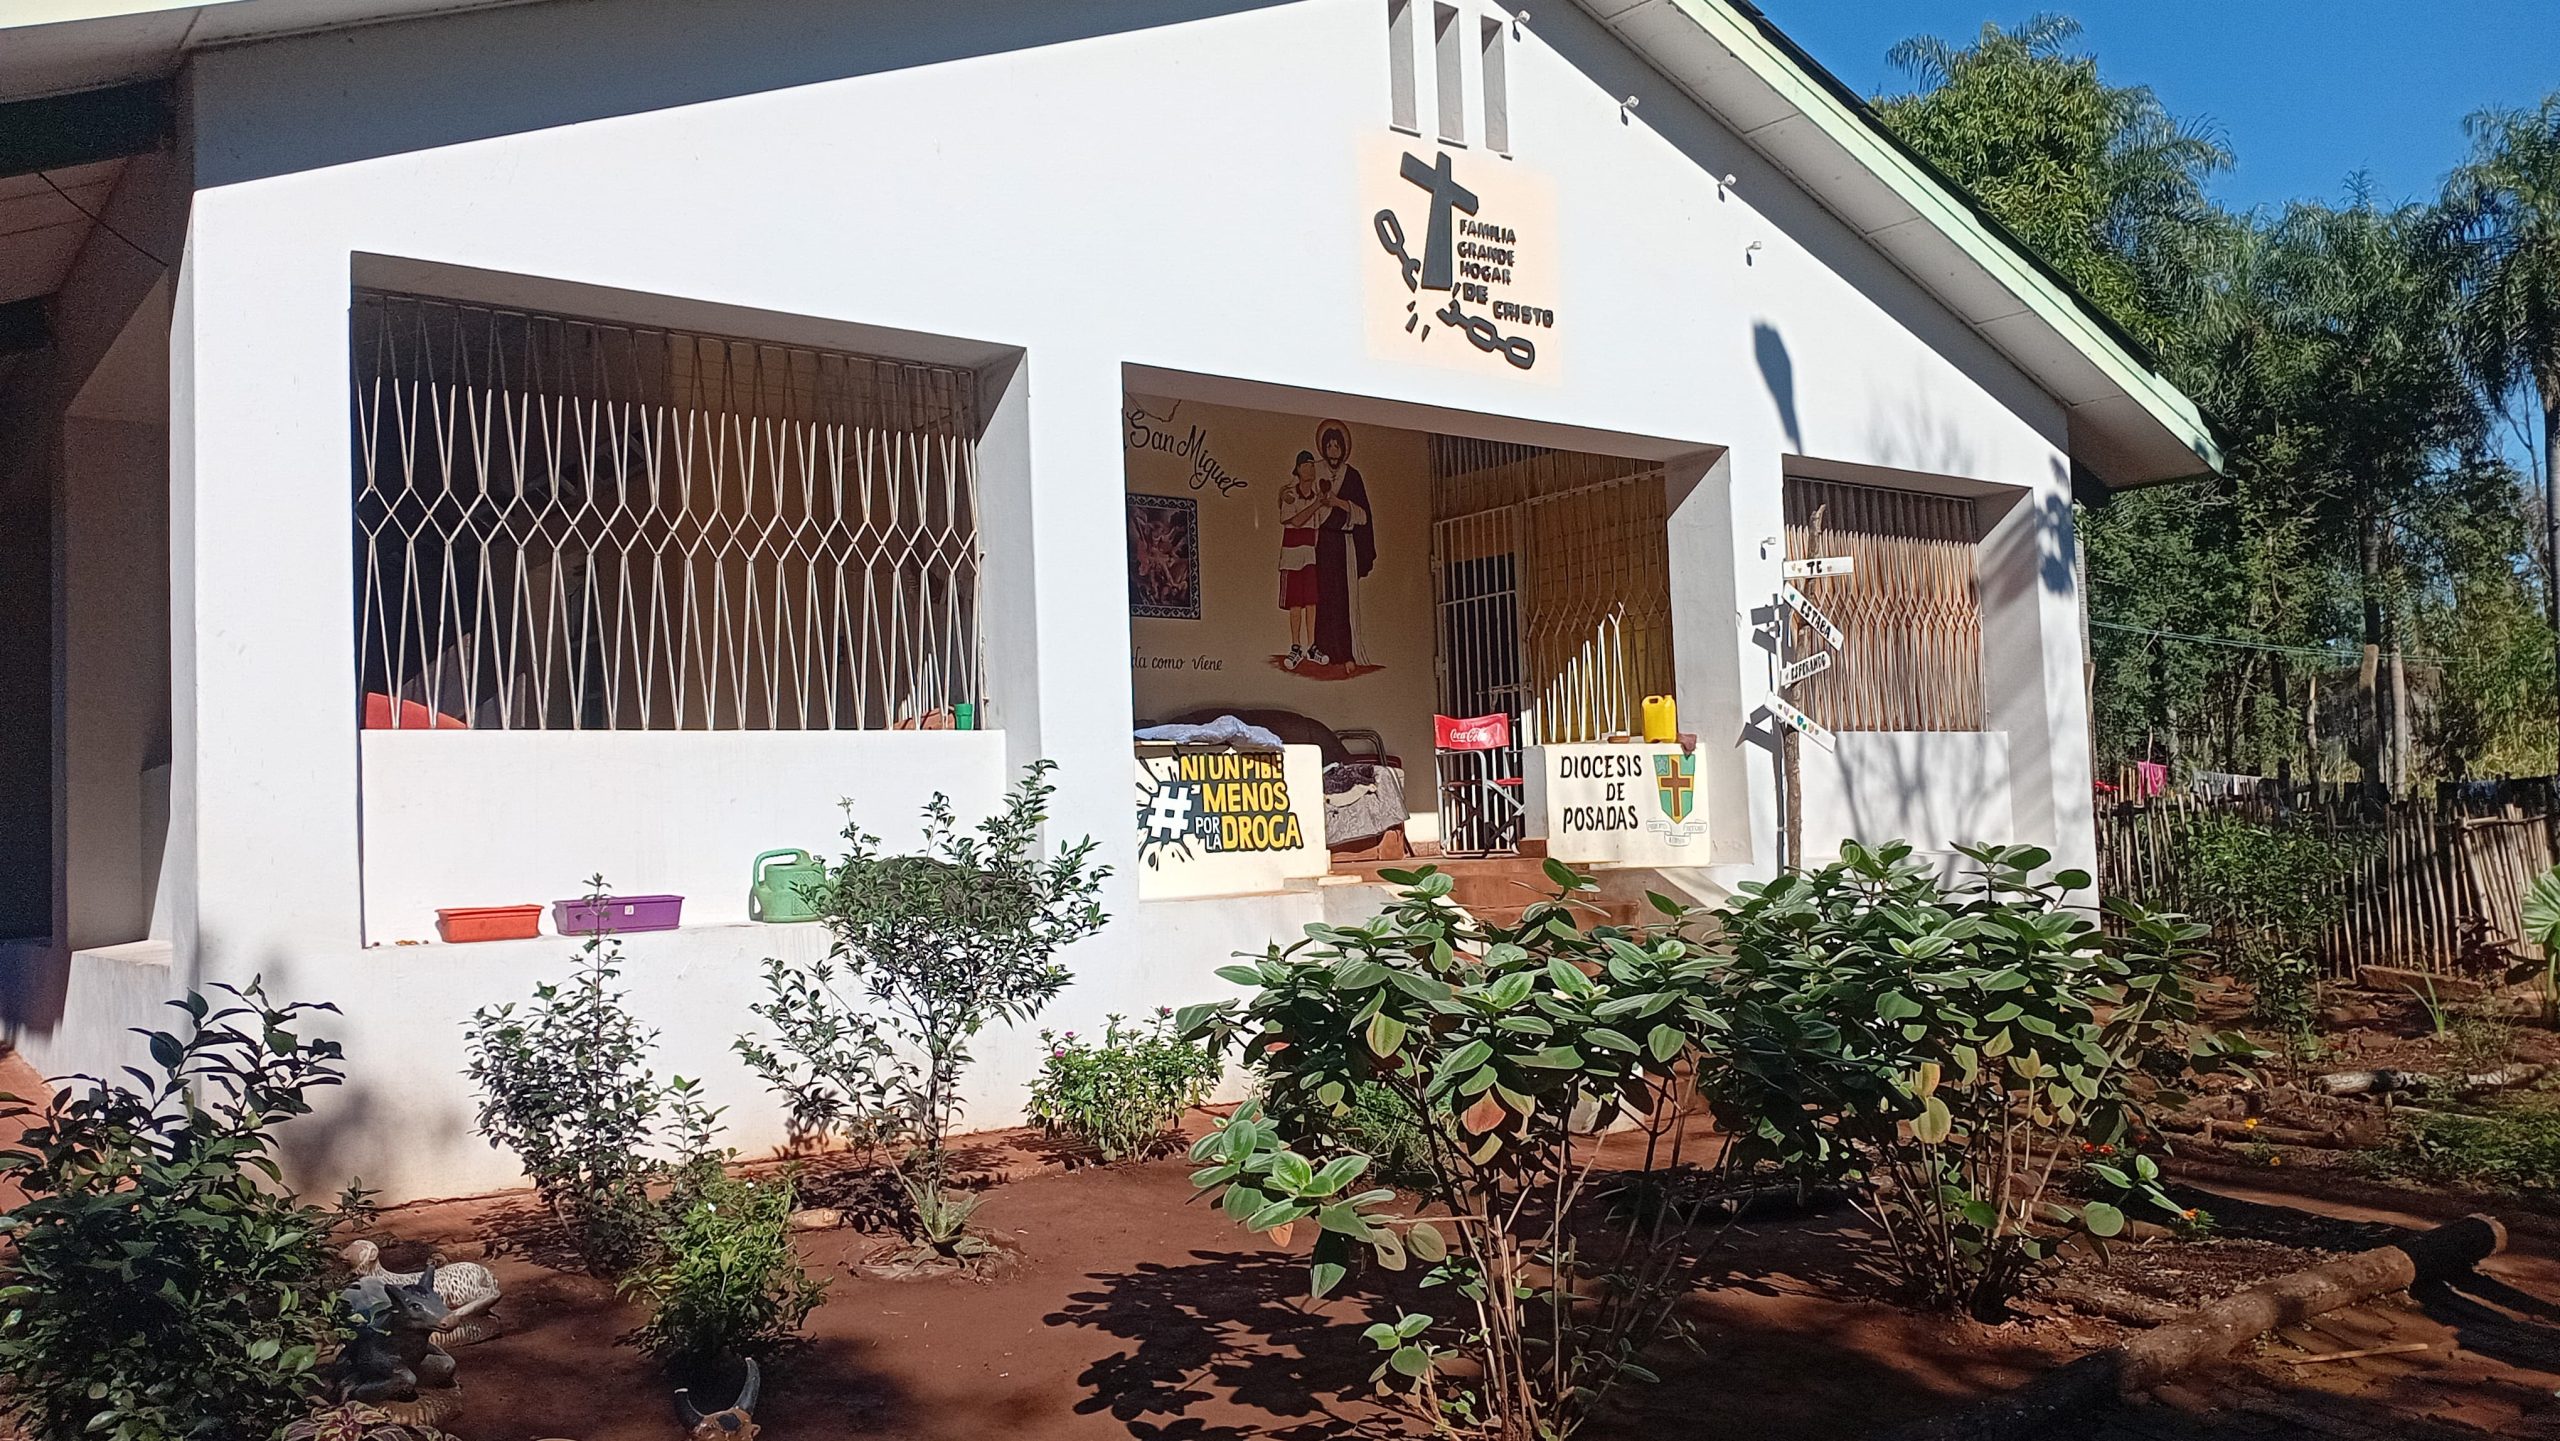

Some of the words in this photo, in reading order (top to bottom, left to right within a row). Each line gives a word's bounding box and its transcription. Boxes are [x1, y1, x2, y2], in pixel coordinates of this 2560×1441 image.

[1460, 218, 1516, 245] FAMILIA
[1457, 241, 1515, 267] GRANDE
[1460, 260, 1511, 286] HOGAR
[1463, 282, 1488, 305] DE
[1493, 301, 1553, 328] CRISTO
[1126, 409, 1175, 452] San
[1176, 424, 1248, 498] Miguel
[1806, 561, 1823, 575] TE
[1800, 601, 1831, 639] ESTABA
[1151, 656, 1185, 670] como
[1192, 654, 1223, 671] viene
[1180, 754, 1206, 781] NI
[1208, 754, 1240, 780] UN
[1241, 753, 1283, 780] PIBE
[1560, 754, 1642, 779] DIOCESIS
[1202, 781, 1289, 813] MENOS
[1606, 782, 1625, 801] DE
[1195, 816, 1221, 834] POR
[1221, 814, 1302, 849] DROGA
[1563, 805, 1639, 833] POSADAS
[1205, 834, 1222, 850] LA
